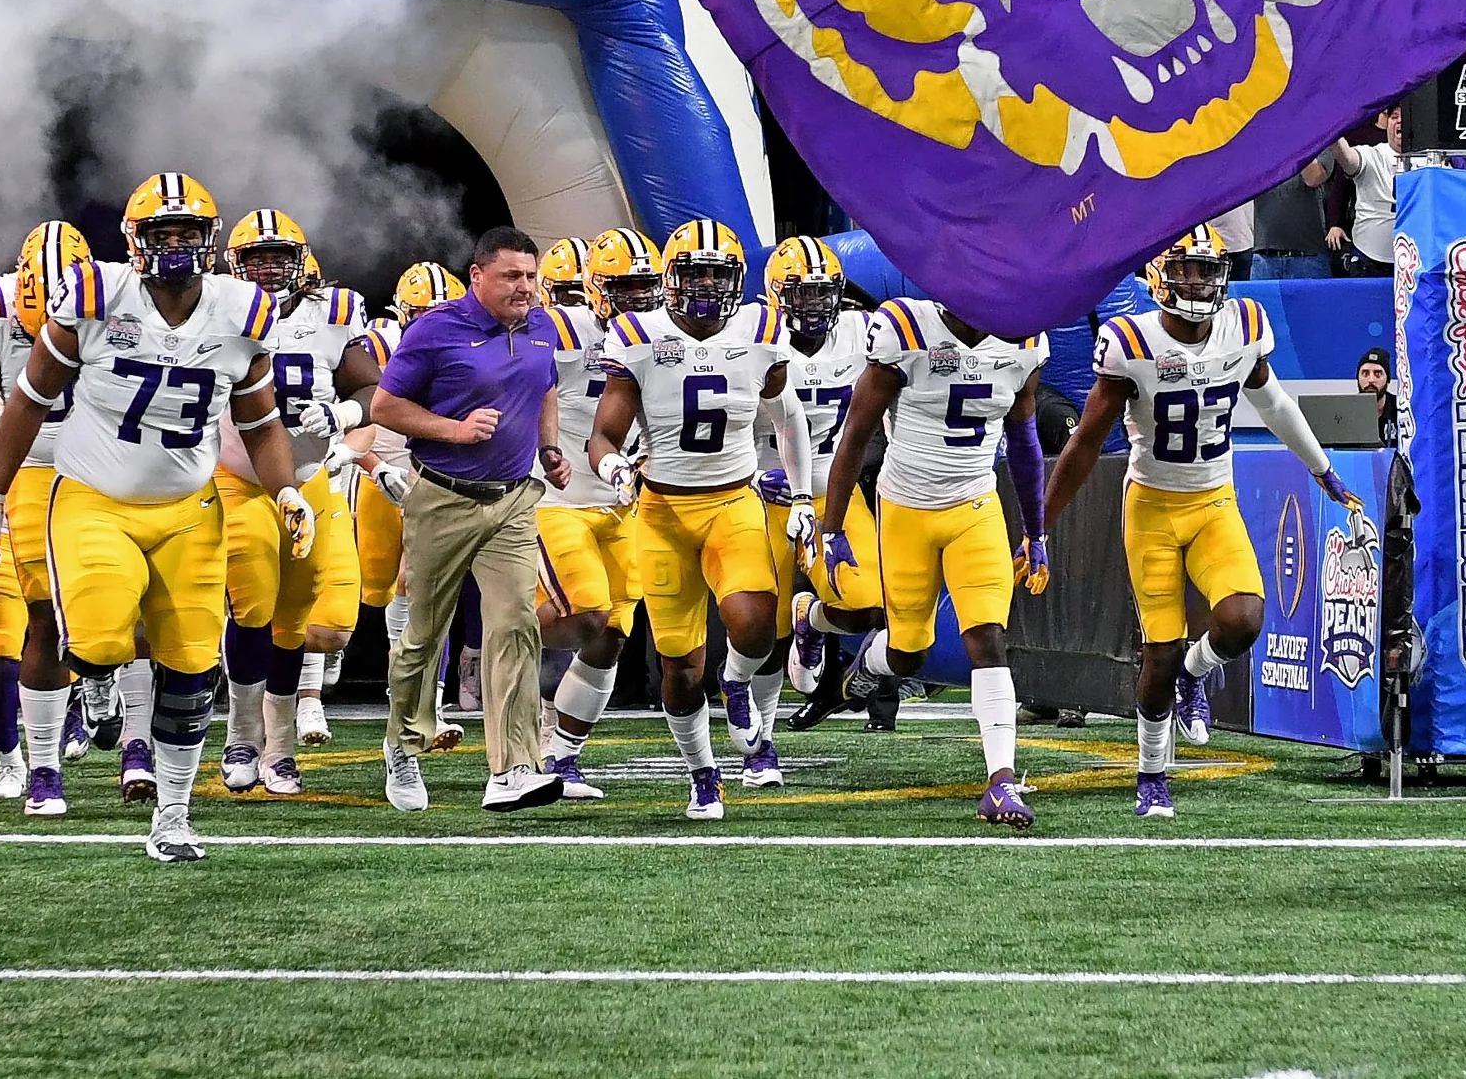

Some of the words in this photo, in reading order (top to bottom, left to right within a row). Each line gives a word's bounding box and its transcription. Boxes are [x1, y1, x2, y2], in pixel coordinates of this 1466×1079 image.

[1070, 192, 1097, 225] MT
[156, 354, 179, 365] LSU
[693, 364, 714, 372] LSU
[963, 373, 982, 381] LSU
[1191, 378, 1210, 386] LSU
[112, 356, 216, 449] 73
[679, 374, 728, 453] 6
[943, 383, 993, 446] 5
[1152, 381, 1241, 463] 83
[1323, 602, 1376, 639] PEACH
[1267, 632, 1308, 660] PLAYOFF
[1333, 637, 1366, 656] BOWL
[1261, 661, 1309, 691] SEMIFINAL
